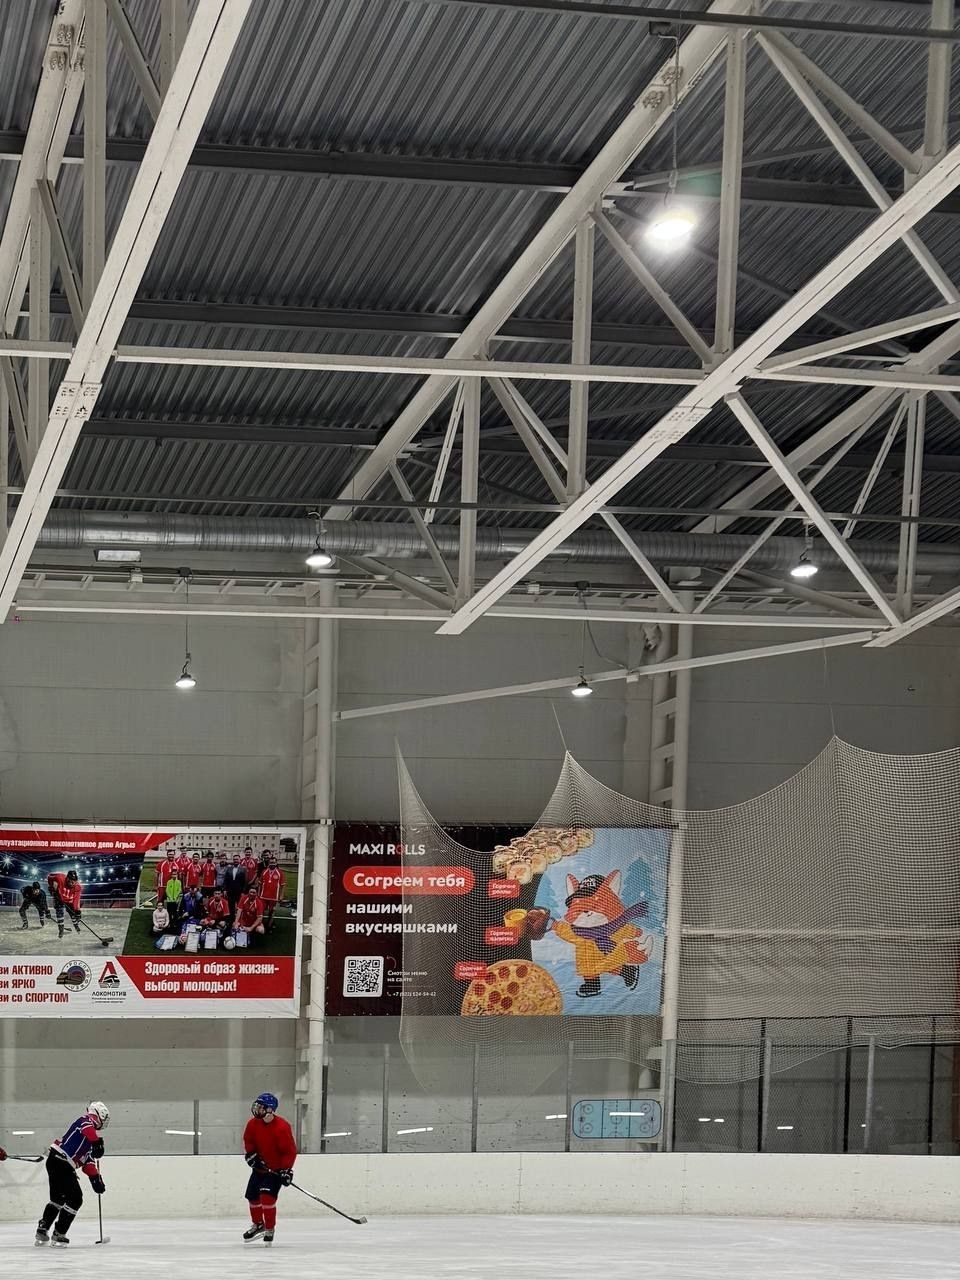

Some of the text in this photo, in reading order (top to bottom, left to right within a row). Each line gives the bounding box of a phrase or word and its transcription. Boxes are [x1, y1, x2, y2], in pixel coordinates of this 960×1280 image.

[50, 840, 97, 848] локомотивное
[349, 843, 426, 855] MAXI ROLLS
[353, 873, 466, 890] Согреем тебя
[346, 903, 414, 914] нашими
[345, 923, 458, 936] вкусняшками
[12, 965, 53, 975] АКТИВНО
[145, 961, 279, 976] Здоровый образ жизни-
[12, 979, 36, 989] ЯРКО
[144, 980, 237, 993] выбор молодых!
[11, 994, 23, 1003] со
[25, 993, 69, 1003] СПОРТОМ
